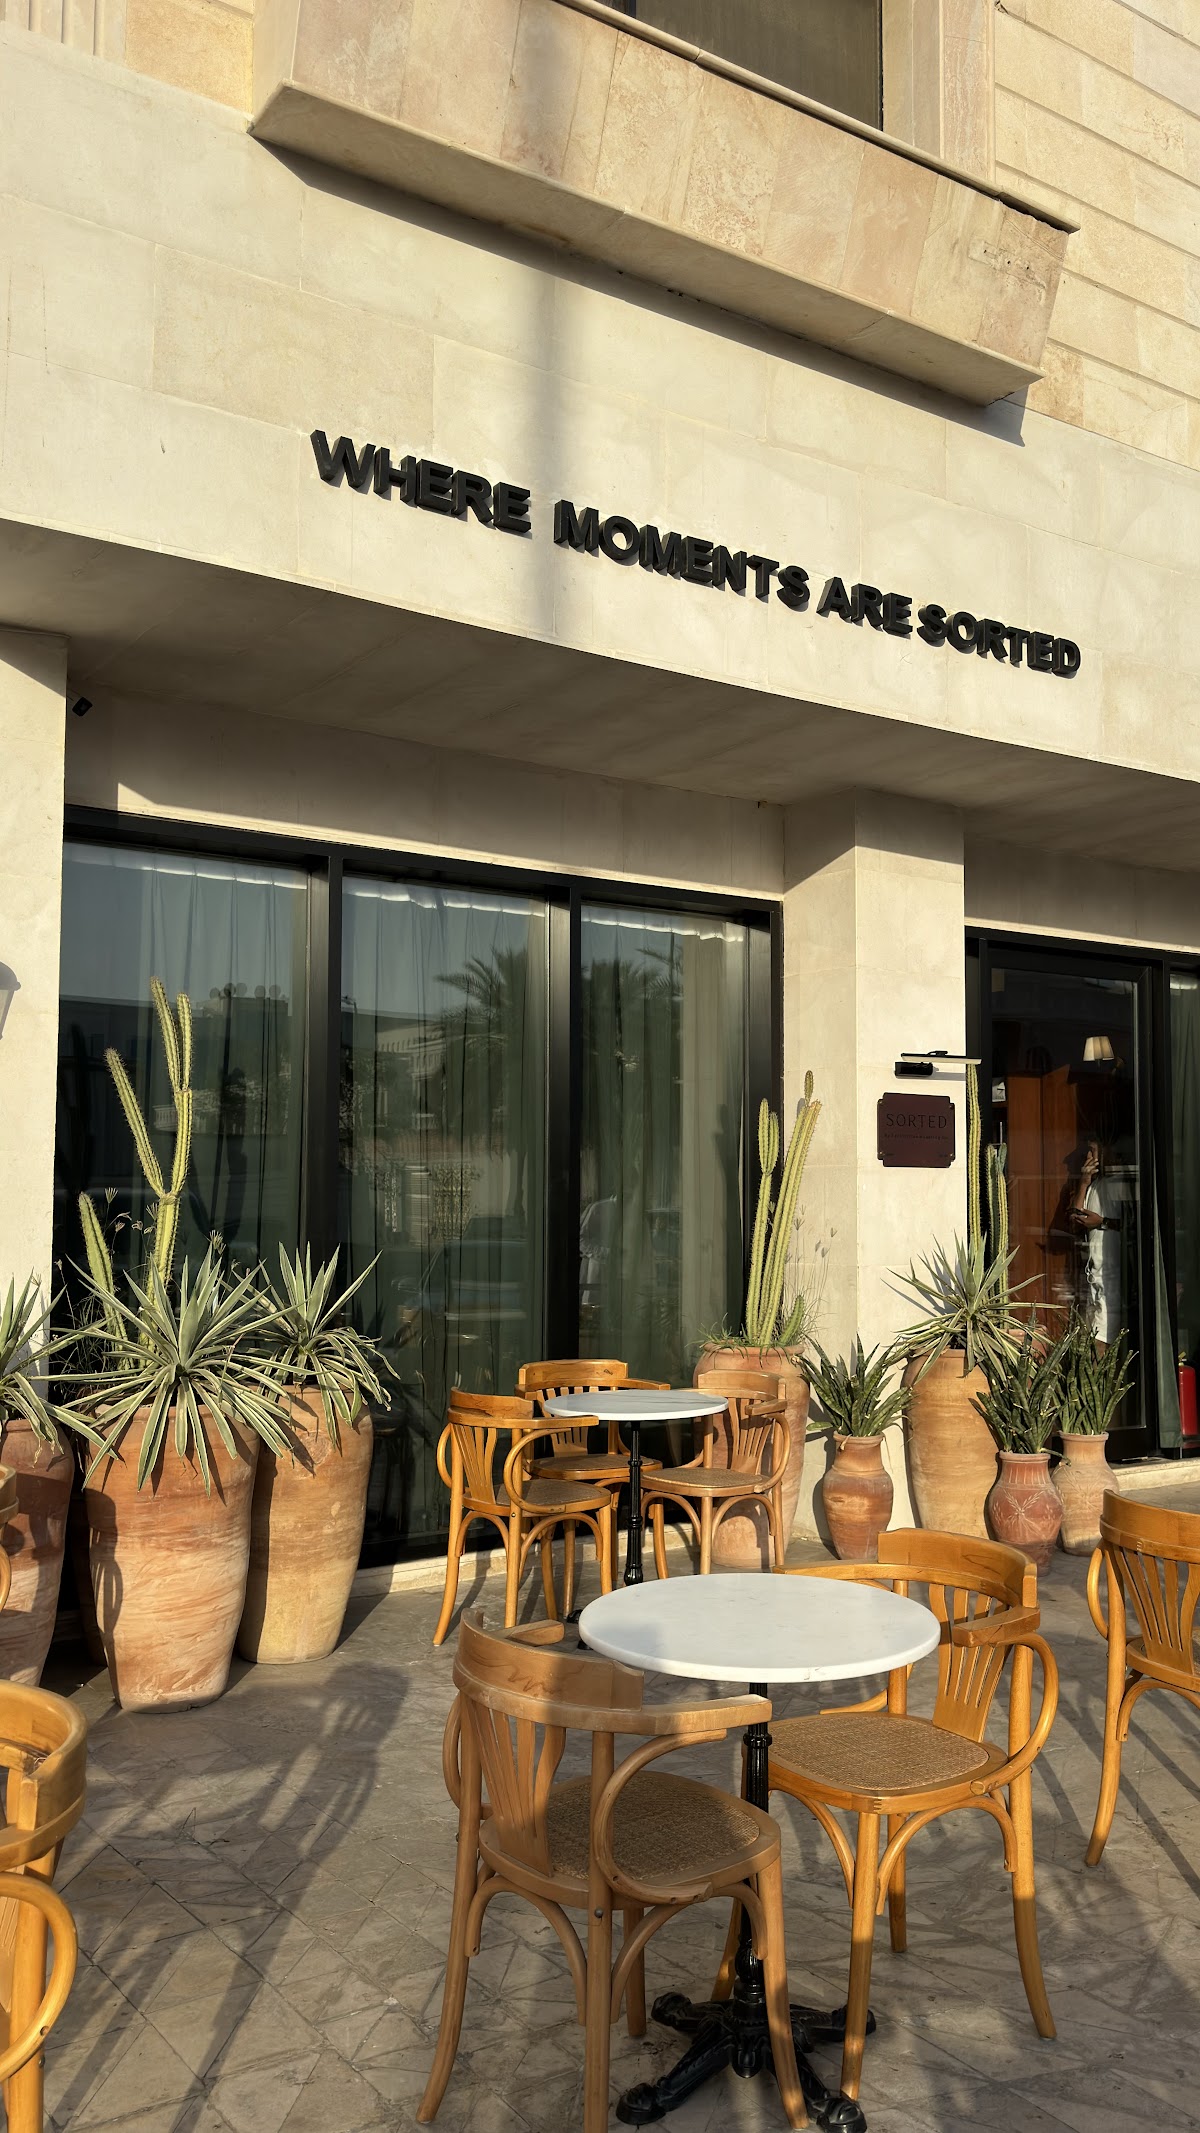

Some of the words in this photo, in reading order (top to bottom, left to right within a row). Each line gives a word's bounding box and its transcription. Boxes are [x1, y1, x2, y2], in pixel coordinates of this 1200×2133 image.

[310, 429, 531, 533] WHERE
[553, 499, 810, 606] MOMENTS
[816, 577, 912, 635] ARE
[917, 604, 1081, 676] SORTED
[886, 1113, 947, 1129] SORTED
